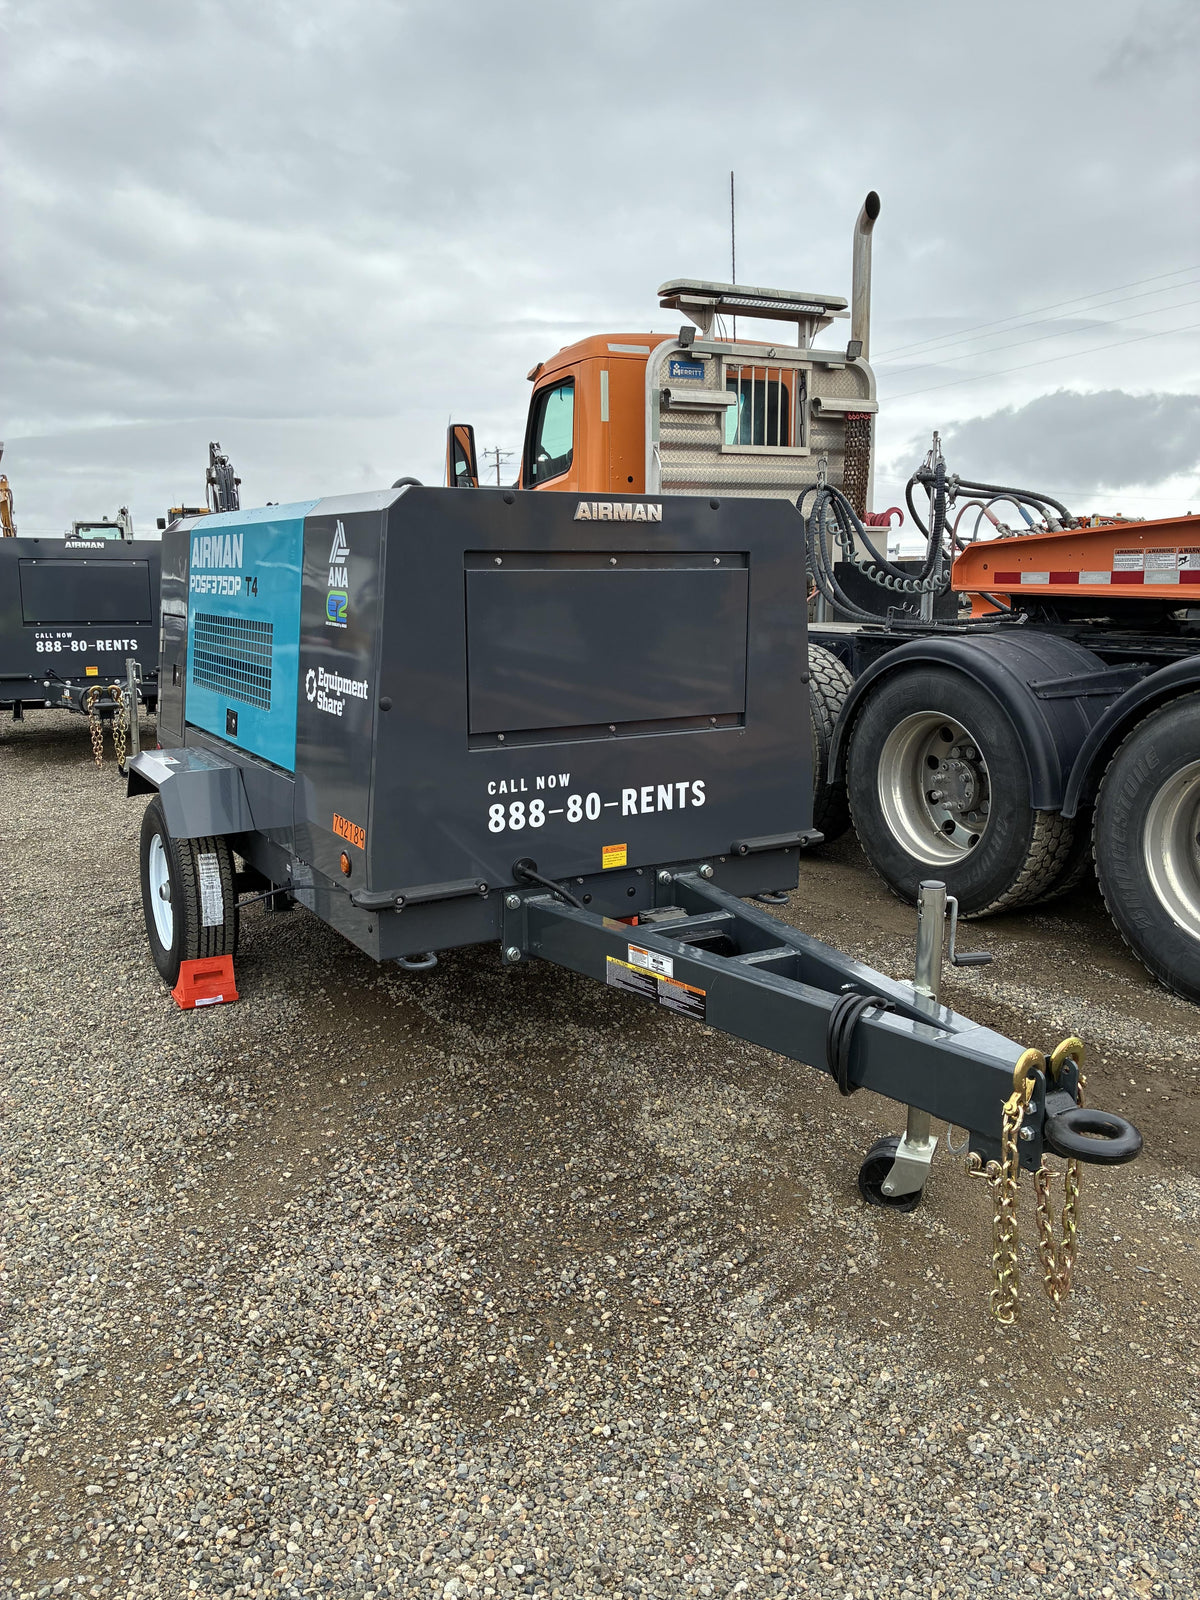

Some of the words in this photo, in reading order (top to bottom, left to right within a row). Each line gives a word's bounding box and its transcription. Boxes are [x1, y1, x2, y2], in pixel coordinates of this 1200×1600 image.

[574, 501, 663, 522] AIRMAN
[64, 541, 105, 549] AIRMAN
[191, 533, 244, 569] AIRMAN
[190, 574, 242, 596] PDSF375DP
[245, 576, 258, 597] T4
[328, 566, 349, 588] ANA
[36, 639, 138, 652] 888-80-RENTS
[318, 666, 369, 700] Equipment
[317, 690, 343, 717] Share
[487, 778, 528, 795] CALL
[536, 773, 571, 790] NOW
[488, 779, 706, 833] 888-80-RENTS
[334, 814, 365, 849] 792189
